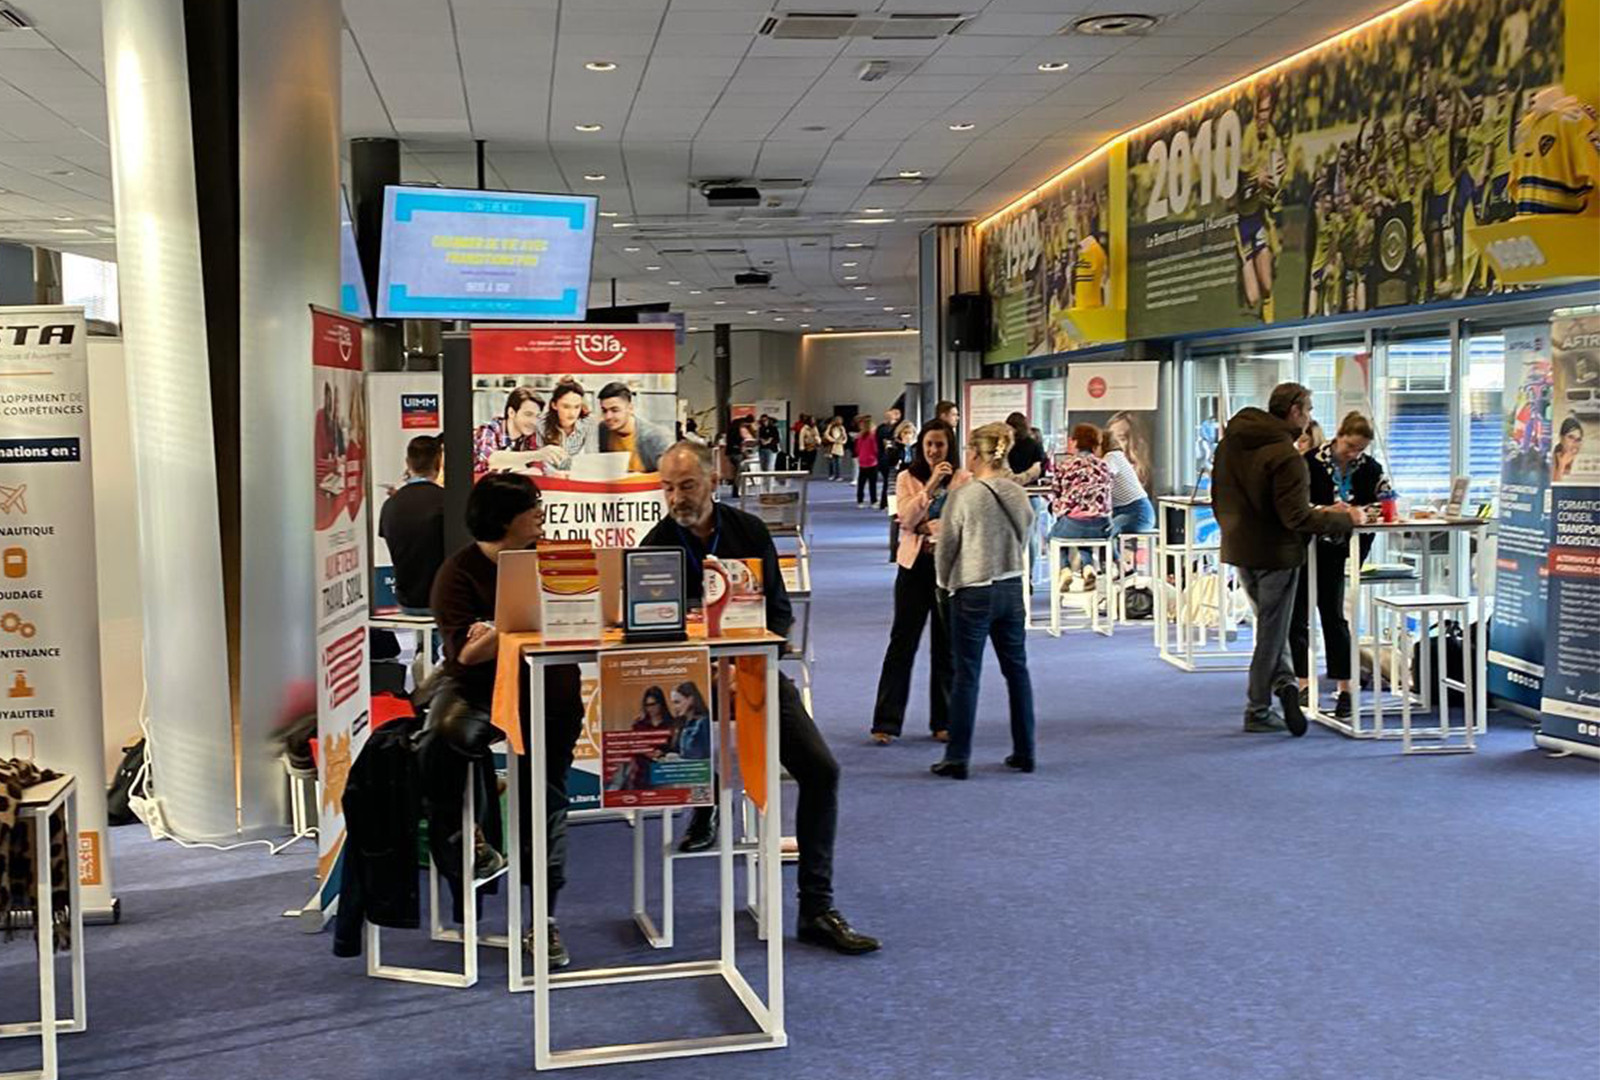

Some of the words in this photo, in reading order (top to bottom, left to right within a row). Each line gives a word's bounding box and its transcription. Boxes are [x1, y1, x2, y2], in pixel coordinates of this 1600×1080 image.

[1147, 110, 1242, 223] 2010
[0, 325, 75, 346] TA
[403, 398, 436, 407] UIMM
[51, 447, 69, 456] en
[574, 502, 596, 523] UN
[602, 498, 661, 522] MÉTIER
[594, 527, 636, 548] SENS
